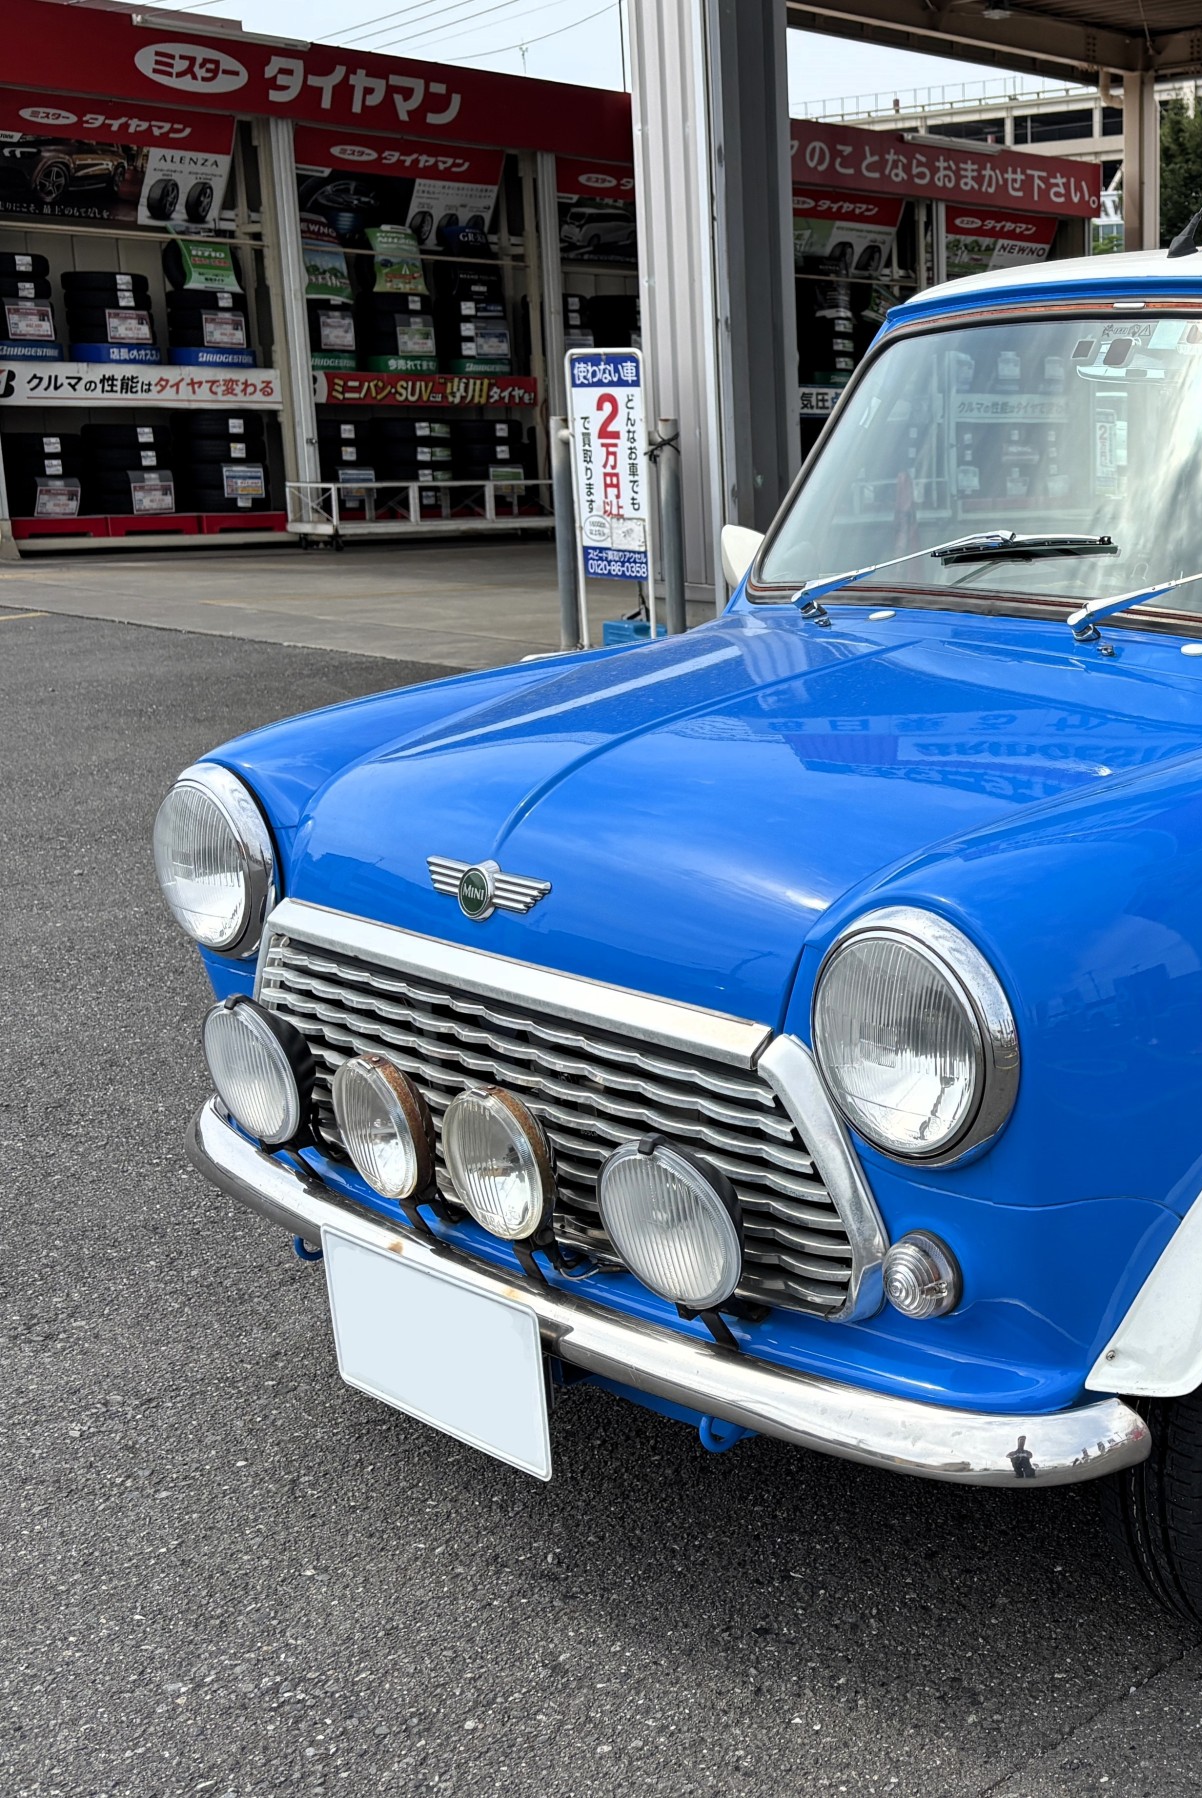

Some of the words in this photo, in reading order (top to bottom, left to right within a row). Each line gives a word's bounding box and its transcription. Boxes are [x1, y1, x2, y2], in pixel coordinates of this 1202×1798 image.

[152, 50, 241, 82] ミスター
[264, 56, 462, 125] タイヤマン
[29, 109, 70, 120] ミスター
[82, 113, 192, 139] タイヤマン
[159, 154, 219, 169] ALENZA
[380, 150, 471, 172] タイヤマン
[816, 199, 879, 216] タイヤマン
[983, 219, 1037, 235] タイヤマン
[998, 243, 1047, 258] NEWNO
[573, 361, 638, 384] 使わない車
[26, 373, 276, 398] クルマの性能はタイヤで変わる
[625, 394, 642, 512] どんなお車でも
[580, 416, 596, 514] で買取ります
[588, 560, 648, 578] 0120-86-0358
[462, 882, 486, 901] MINI
